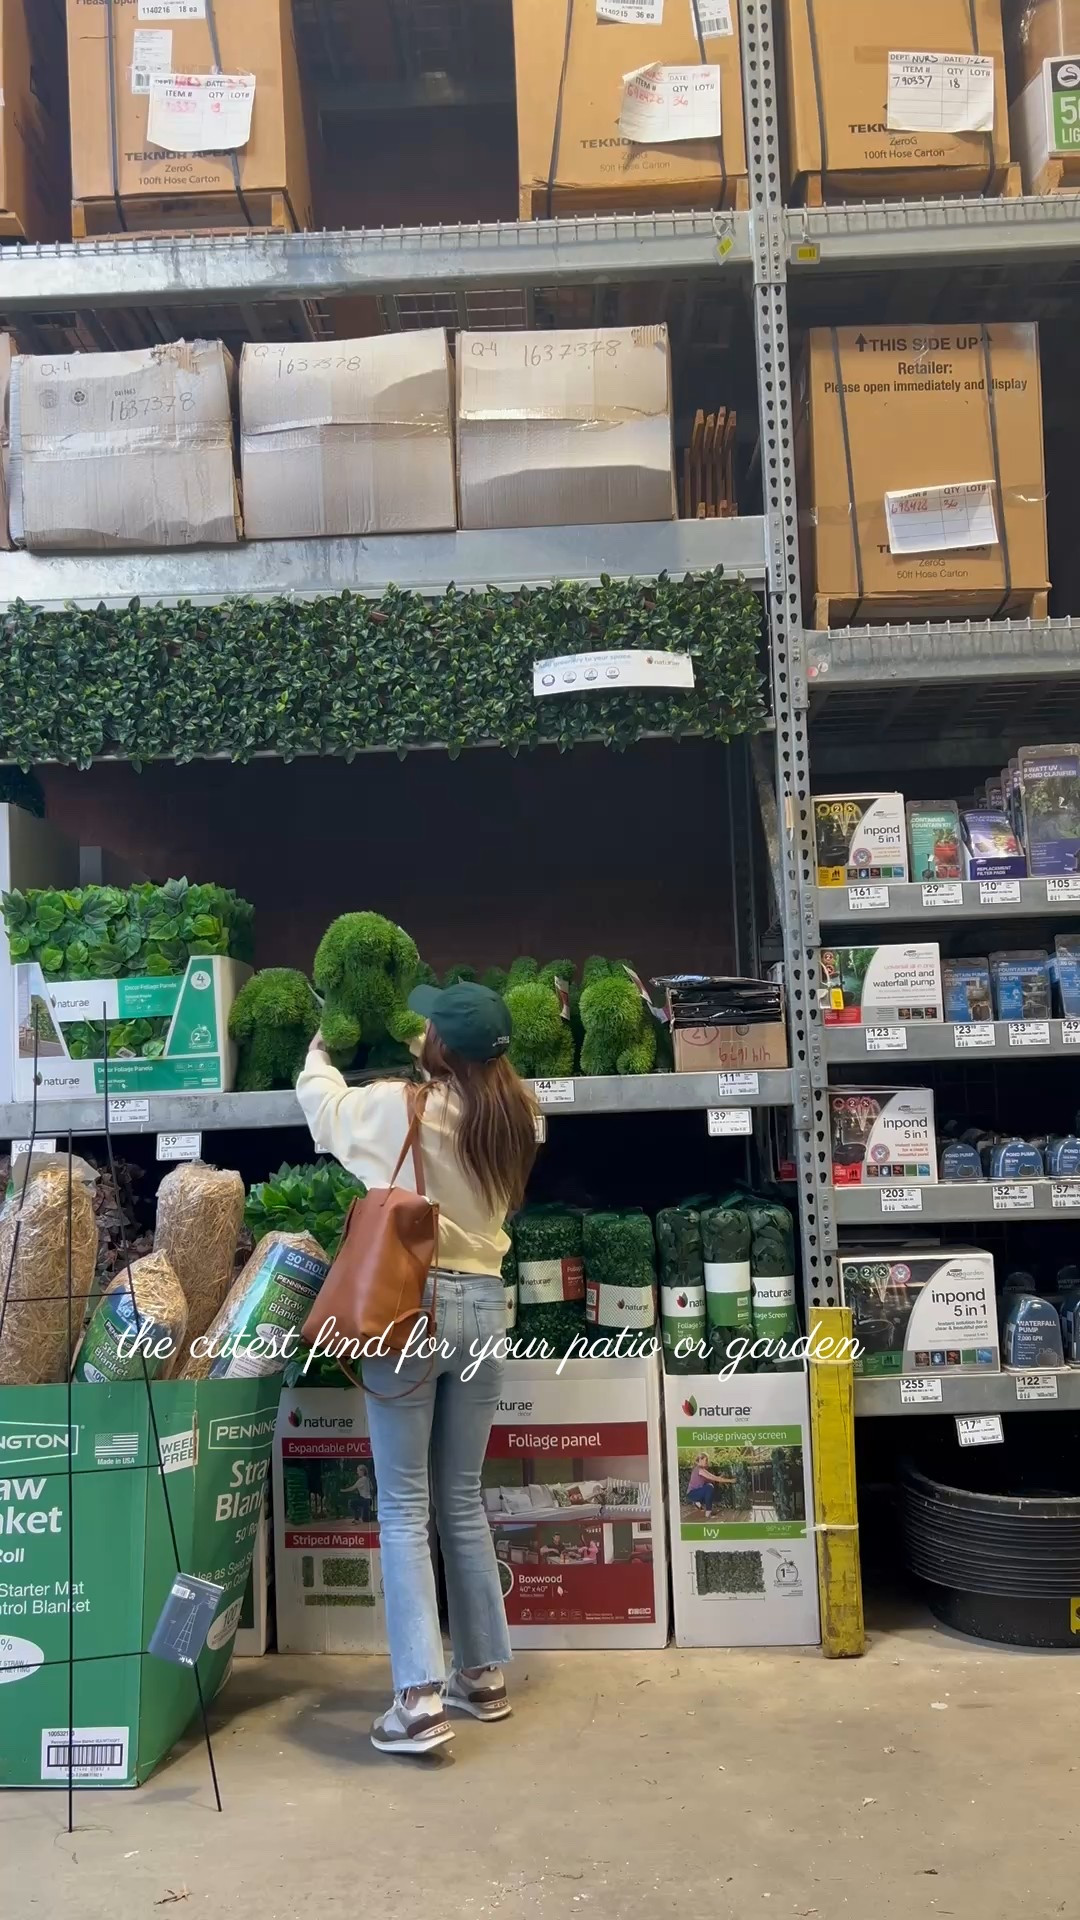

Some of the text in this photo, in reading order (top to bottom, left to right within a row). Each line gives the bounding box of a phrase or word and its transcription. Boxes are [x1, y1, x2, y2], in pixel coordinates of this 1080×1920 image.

[142, 6, 170, 14] 1140216
[179, 5, 187, 13] 18
[635, 11, 645, 19] 36
[947, 68, 963, 76] QTY
[969, 69, 990, 77] LOT#
[892, 75, 961, 88] 790337 18
[889, 136, 918, 146] ZeroG
[863, 148, 945, 160] 100ft Hose Carton
[165, 164, 193, 173] ZeroG
[642, 161, 671, 170] Carton
[138, 175, 220, 185] 100ft Hose Carton
[869, 336, 979, 352] THIS SIDE UP
[523, 340, 622, 368] 1637378
[898, 361, 953, 376] Retailer:
[824, 378, 985, 396] Please open immediately and
[944, 484, 987, 496] QTY LOT#
[918, 557, 946, 568] ZeroG
[897, 568, 969, 579] 50ft Hose Carton
[863, 825, 900, 837] inpond
[878, 834, 901, 844] 5 in 1
[1048, 880, 1070, 888] $105
[850, 887, 871, 897] $161
[196, 973, 205, 983] 4
[894, 969, 935, 979] pond and
[872, 978, 936, 989] waterfall pump
[57, 999, 90, 1008] naturae
[866, 1028, 890, 1038] $123
[43, 1077, 80, 1086] naturae
[883, 1117, 928, 1130] inpond
[904, 1129, 928, 1139] 5 in 1
[882, 1189, 905, 1199] $203
[757, 1288, 792, 1299] naturae
[931, 1288, 986, 1305] inpond
[278, 1292, 305, 1313] Straw
[768, 1311, 788, 1319] Screen
[954, 1303, 987, 1317] 5 in 1
[677, 1321, 699, 1330] Foliage
[94, 1346, 130, 1377] Blanket
[901, 1379, 924, 1390] $255
[1017, 1376, 1040, 1386] $122
[699, 1404, 751, 1418] naturae
[303, 1416, 354, 1429] naturae
[508, 1431, 602, 1450] Foliage panel
[692, 1430, 787, 1442] Foliage privacy screen
[161, 1436, 195, 1455] WEED
[288, 1441, 366, 1455] Expandable PVC
[97, 1457, 113, 1465] Made
[122, 1457, 135, 1465] USA
[163, 1450, 196, 1466] FREE
[703, 1526, 720, 1539] Ivy
[293, 1534, 366, 1546] Striped Maple
[213, 1560, 246, 1579] as Seed
[518, 1574, 563, 1584] Boxwood
[0, 1581, 85, 1598] Starter Mat
[32, 1597, 91, 1615] Blanket
